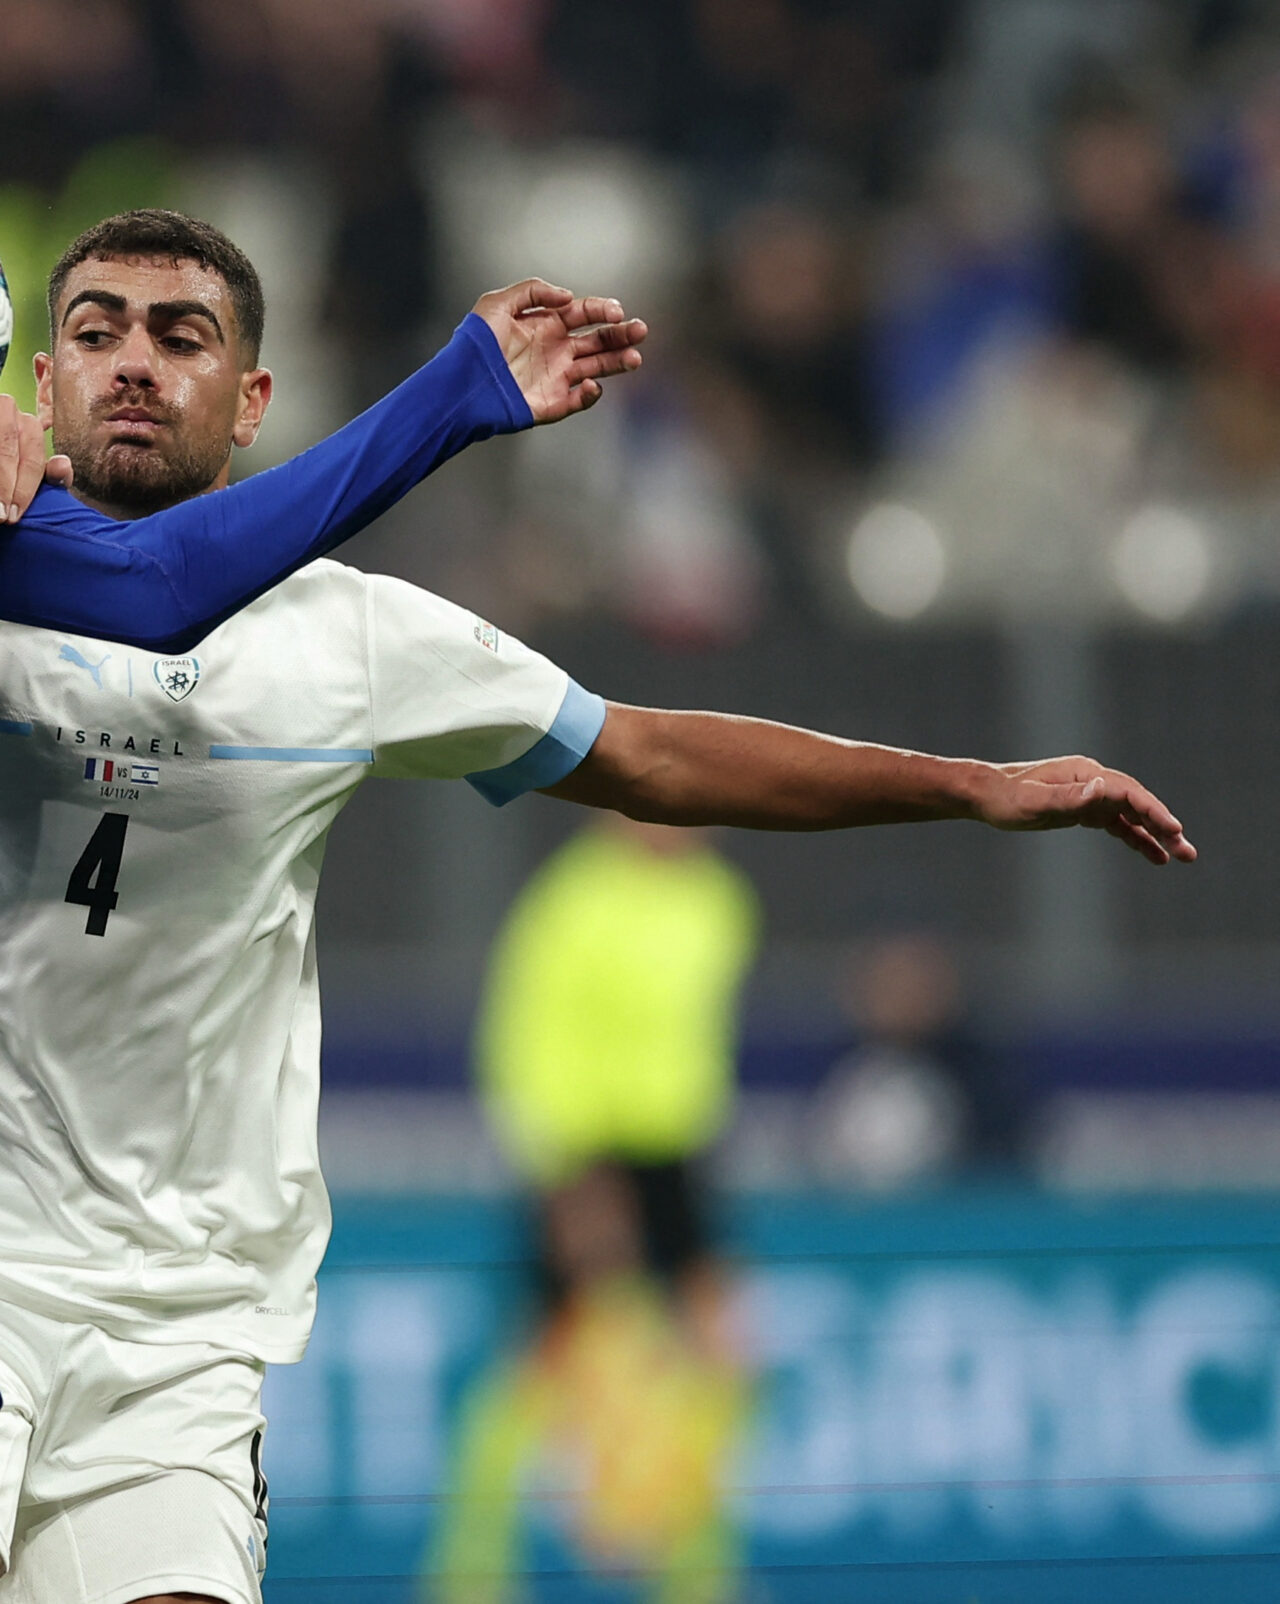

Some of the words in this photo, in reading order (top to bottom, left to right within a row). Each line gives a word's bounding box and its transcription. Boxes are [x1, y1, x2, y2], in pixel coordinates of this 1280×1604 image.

[161, 659, 192, 667] ISRAEL
[56, 727, 184, 756] ISRAEL
[117, 768, 128, 778] VS
[100, 786, 140, 801] 14/11/24
[64, 812, 129, 937] 4
[255, 1305, 290, 1316] DRYCELL
